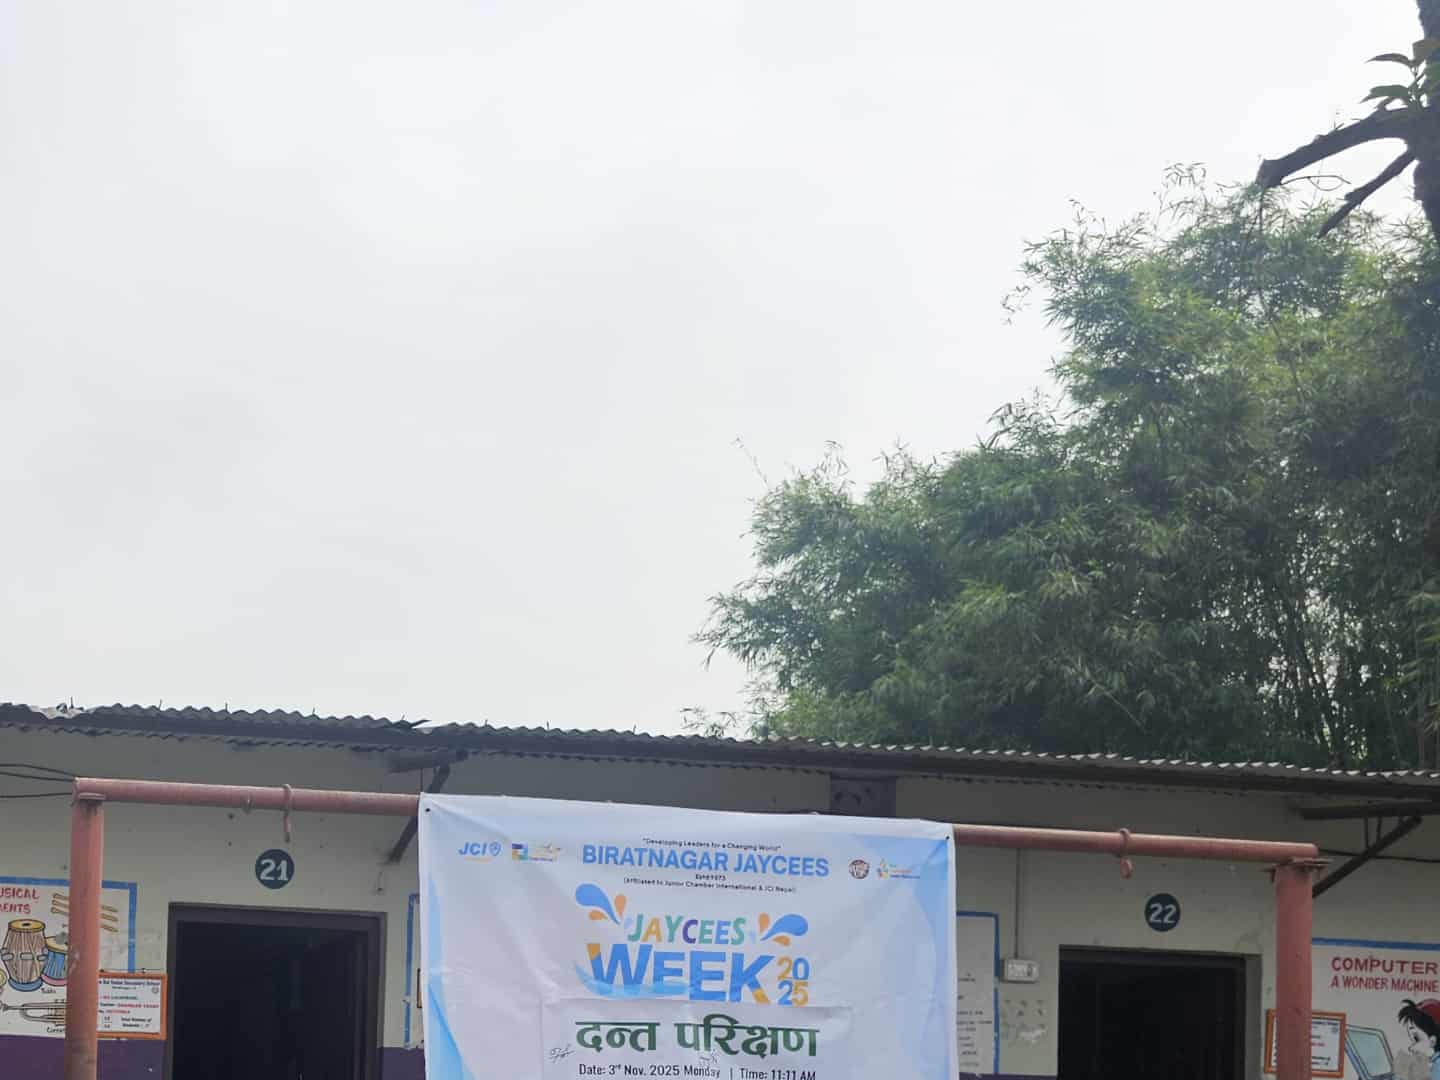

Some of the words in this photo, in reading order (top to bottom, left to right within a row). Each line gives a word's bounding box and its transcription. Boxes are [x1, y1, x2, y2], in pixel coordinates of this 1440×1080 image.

[458, 842, 487, 856] JCI
[260, 859, 288, 881] 21
[581, 843, 729, 872] BIRATNAGAR
[733, 854, 830, 878] JAYCEES
[1150, 903, 1177, 923] 22
[627, 913, 747, 946] JAYCEES
[586, 943, 776, 1005] WEEK
[1331, 956, 1438, 975] COMPUTER
[1330, 975, 1340, 989] A
[1342, 976, 1388, 990] WONDER
[1391, 978, 1440, 993] MACHINE
[575, 1021, 661, 1053] दन्त
[674, 1013, 821, 1059] परिक्षण
[578, 1063, 606, 1076] Date:
[624, 1064, 647, 1077] Nov.
[650, 1064, 680, 1077] 2025
[684, 1065, 721, 1079] Monday
[739, 1067, 768, 1080] Time:
[771, 1068, 796, 1080] 11:11
